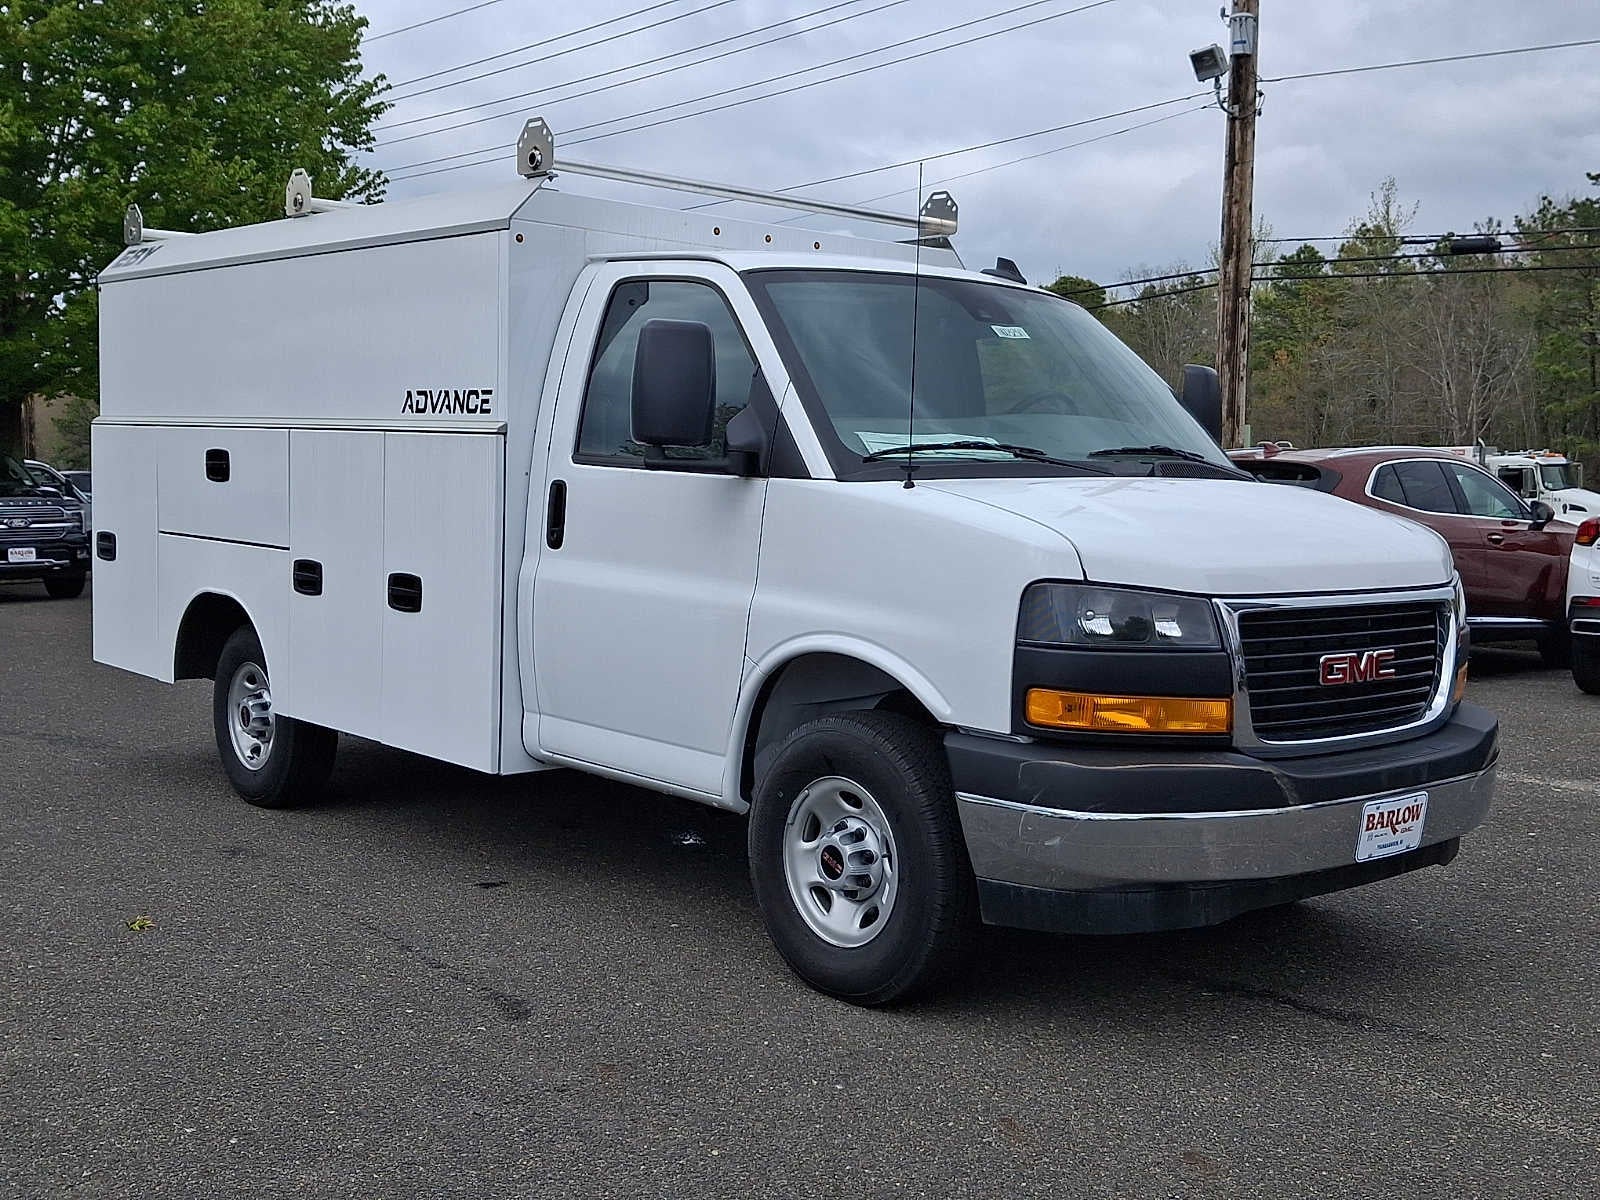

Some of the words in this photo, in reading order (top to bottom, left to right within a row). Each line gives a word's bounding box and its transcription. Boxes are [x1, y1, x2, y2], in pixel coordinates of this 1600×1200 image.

[401, 389, 493, 414] ADVANCE
[1319, 649, 1396, 685] GMC
[1365, 803, 1423, 835] BARLOW
